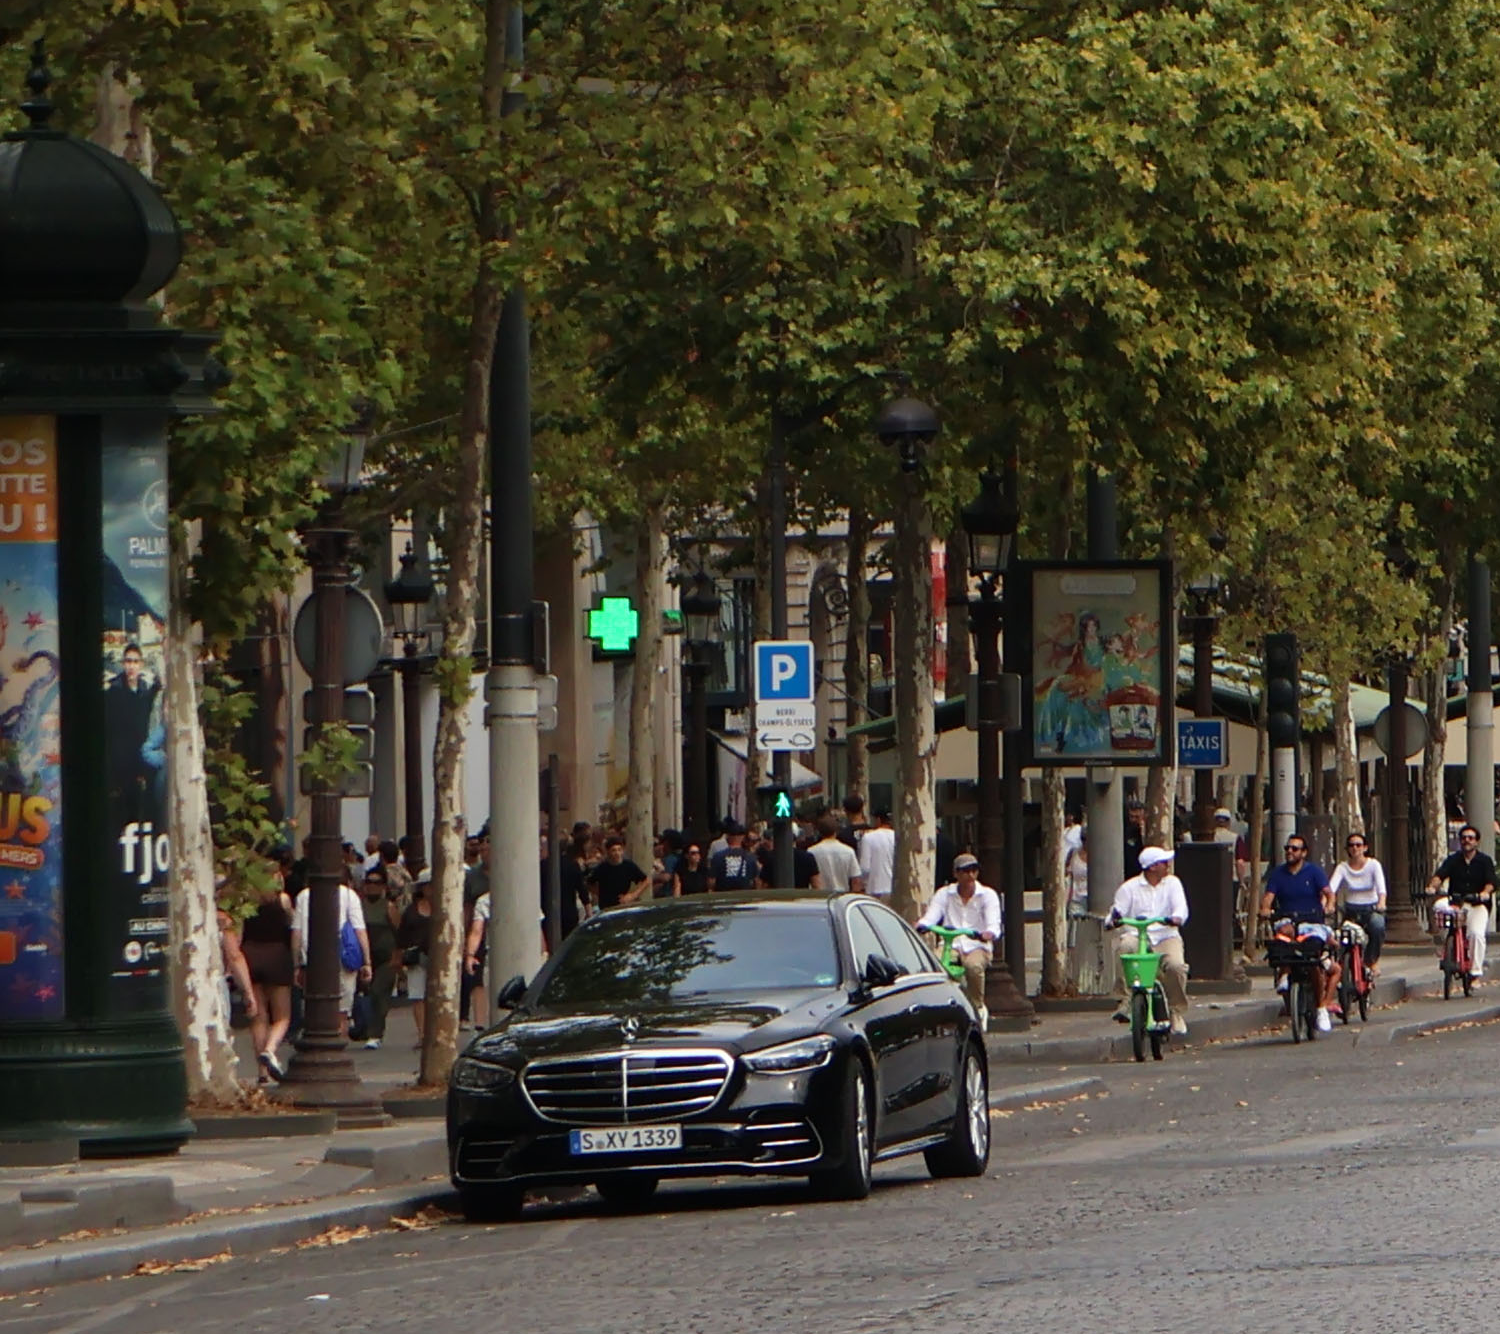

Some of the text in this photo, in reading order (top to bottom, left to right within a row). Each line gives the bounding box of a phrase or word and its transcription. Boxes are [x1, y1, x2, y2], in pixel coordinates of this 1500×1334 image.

[772, 654, 797, 691] P
[1180, 736, 1220, 750] TAXIS
[582, 1133, 594, 1150] S
[632, 1129, 677, 1148] 1339
